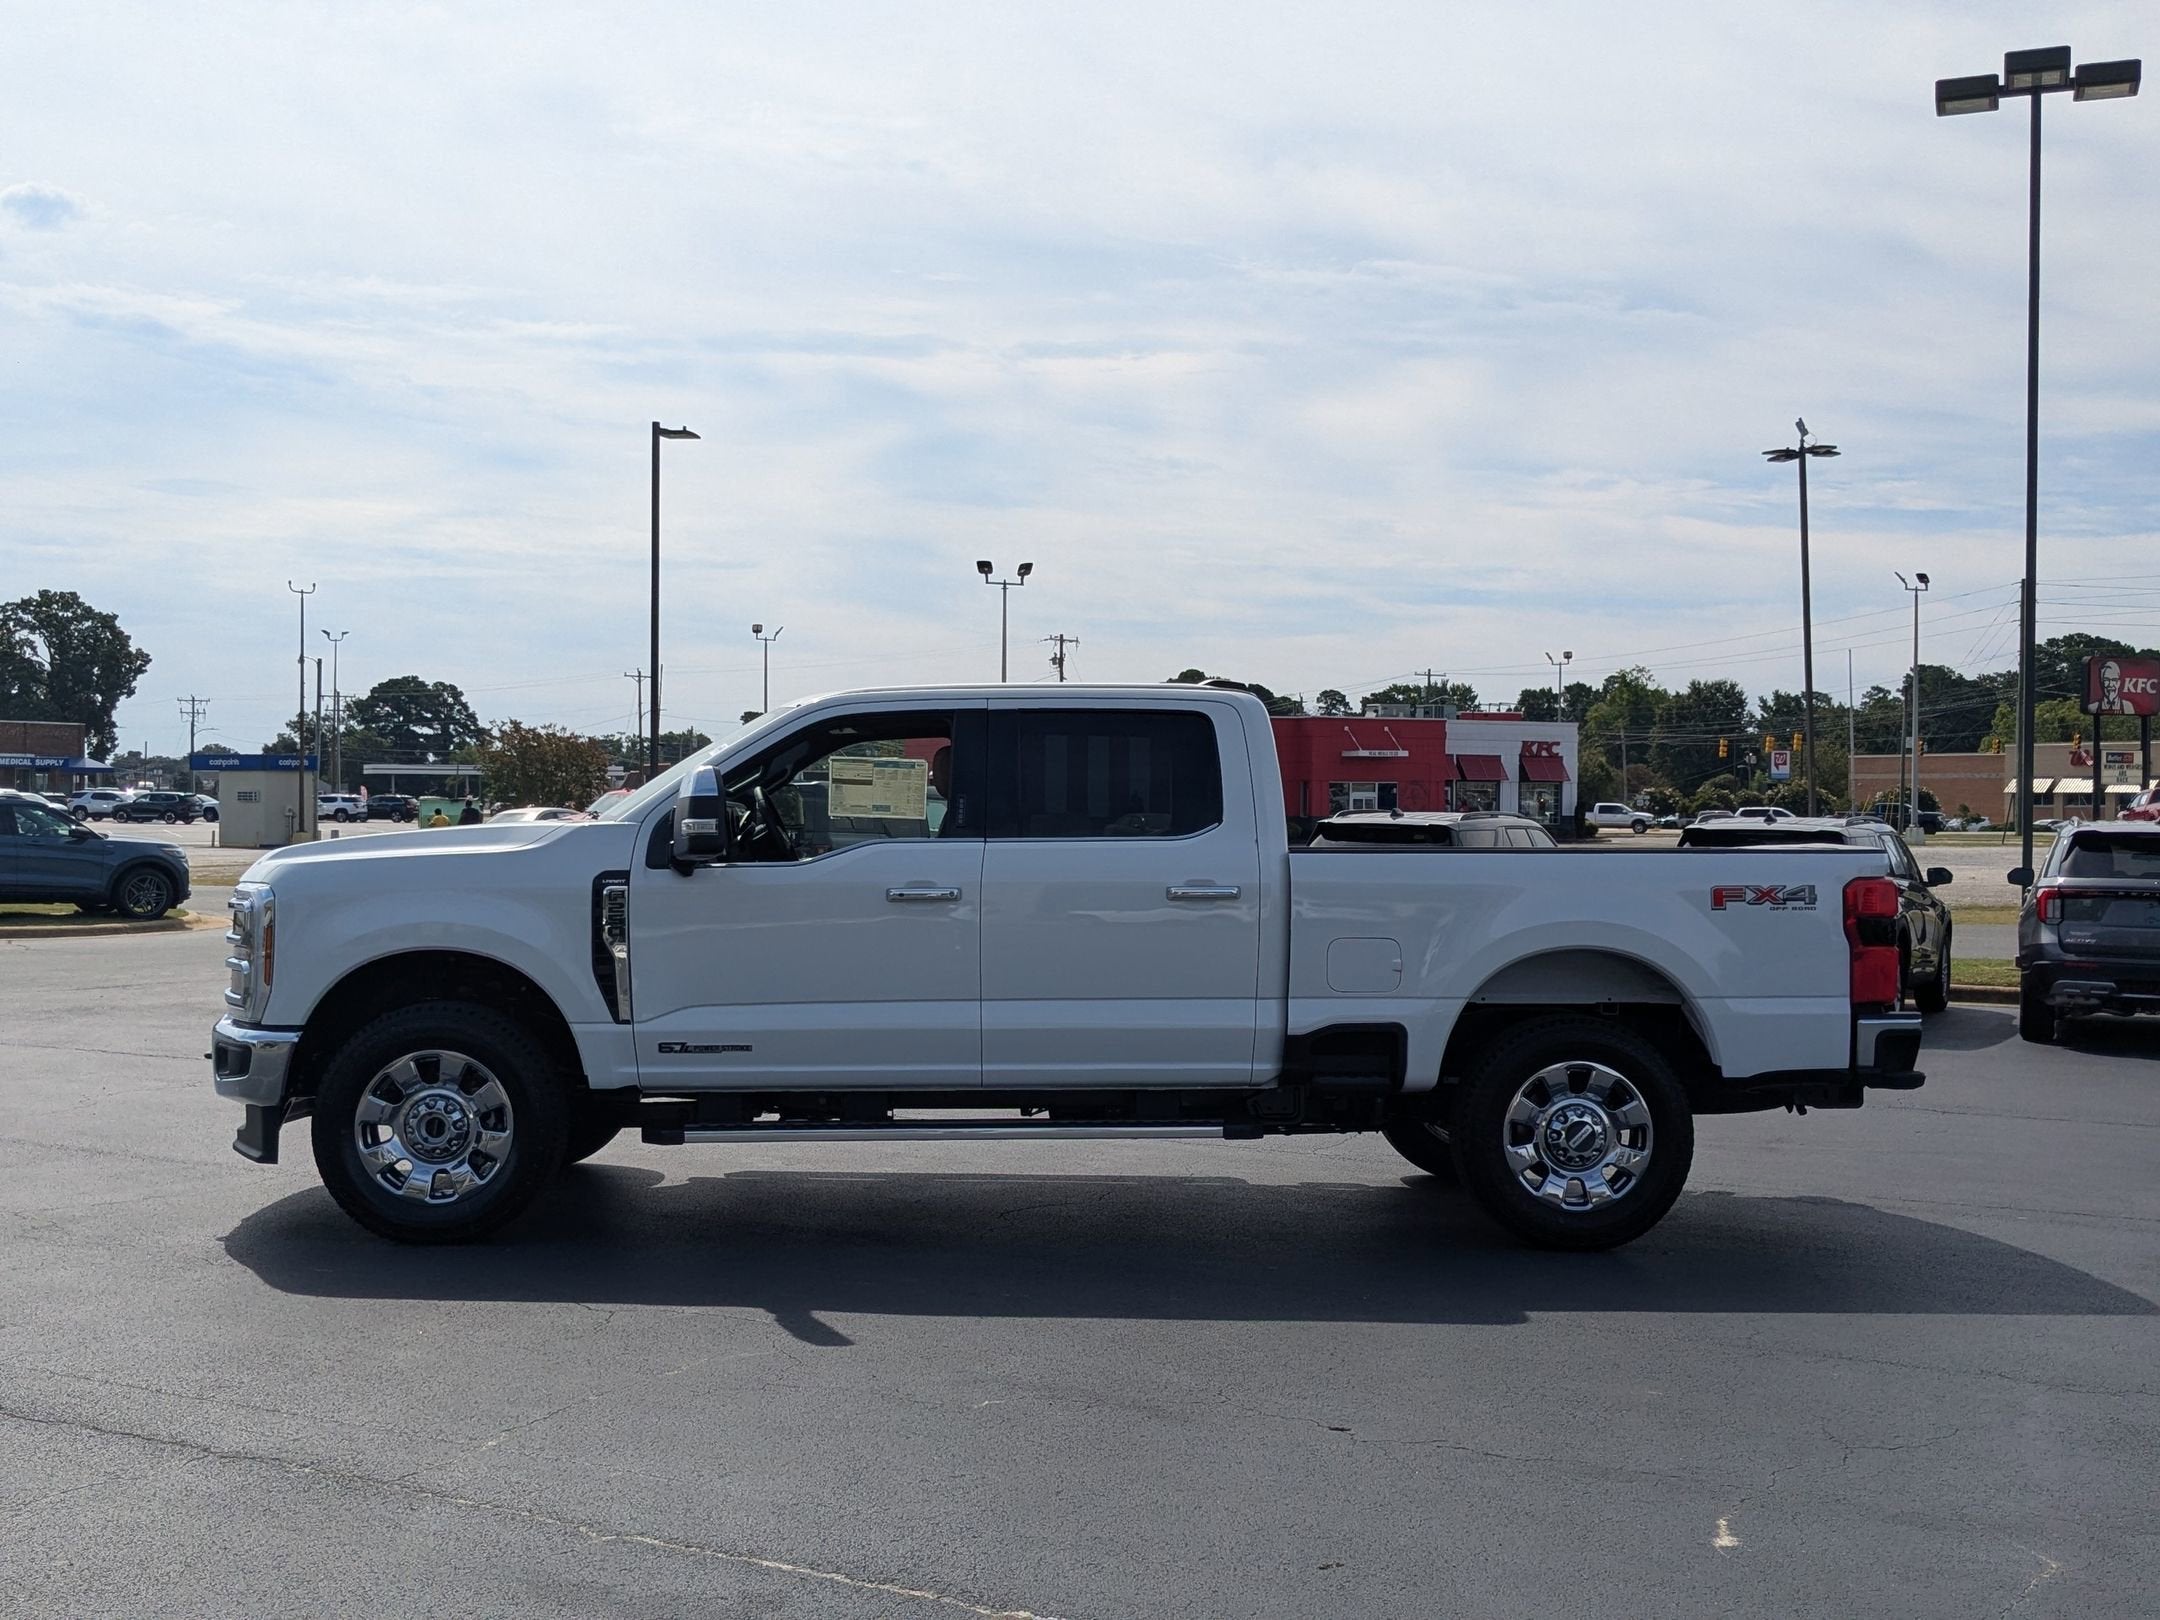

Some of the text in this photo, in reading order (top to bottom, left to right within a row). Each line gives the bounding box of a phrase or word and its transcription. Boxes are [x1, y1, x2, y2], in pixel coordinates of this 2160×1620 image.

[2122, 677, 2158, 694] KFC
[1520, 740, 1561, 757] KFC
[1710, 885, 1818, 911] FX4
